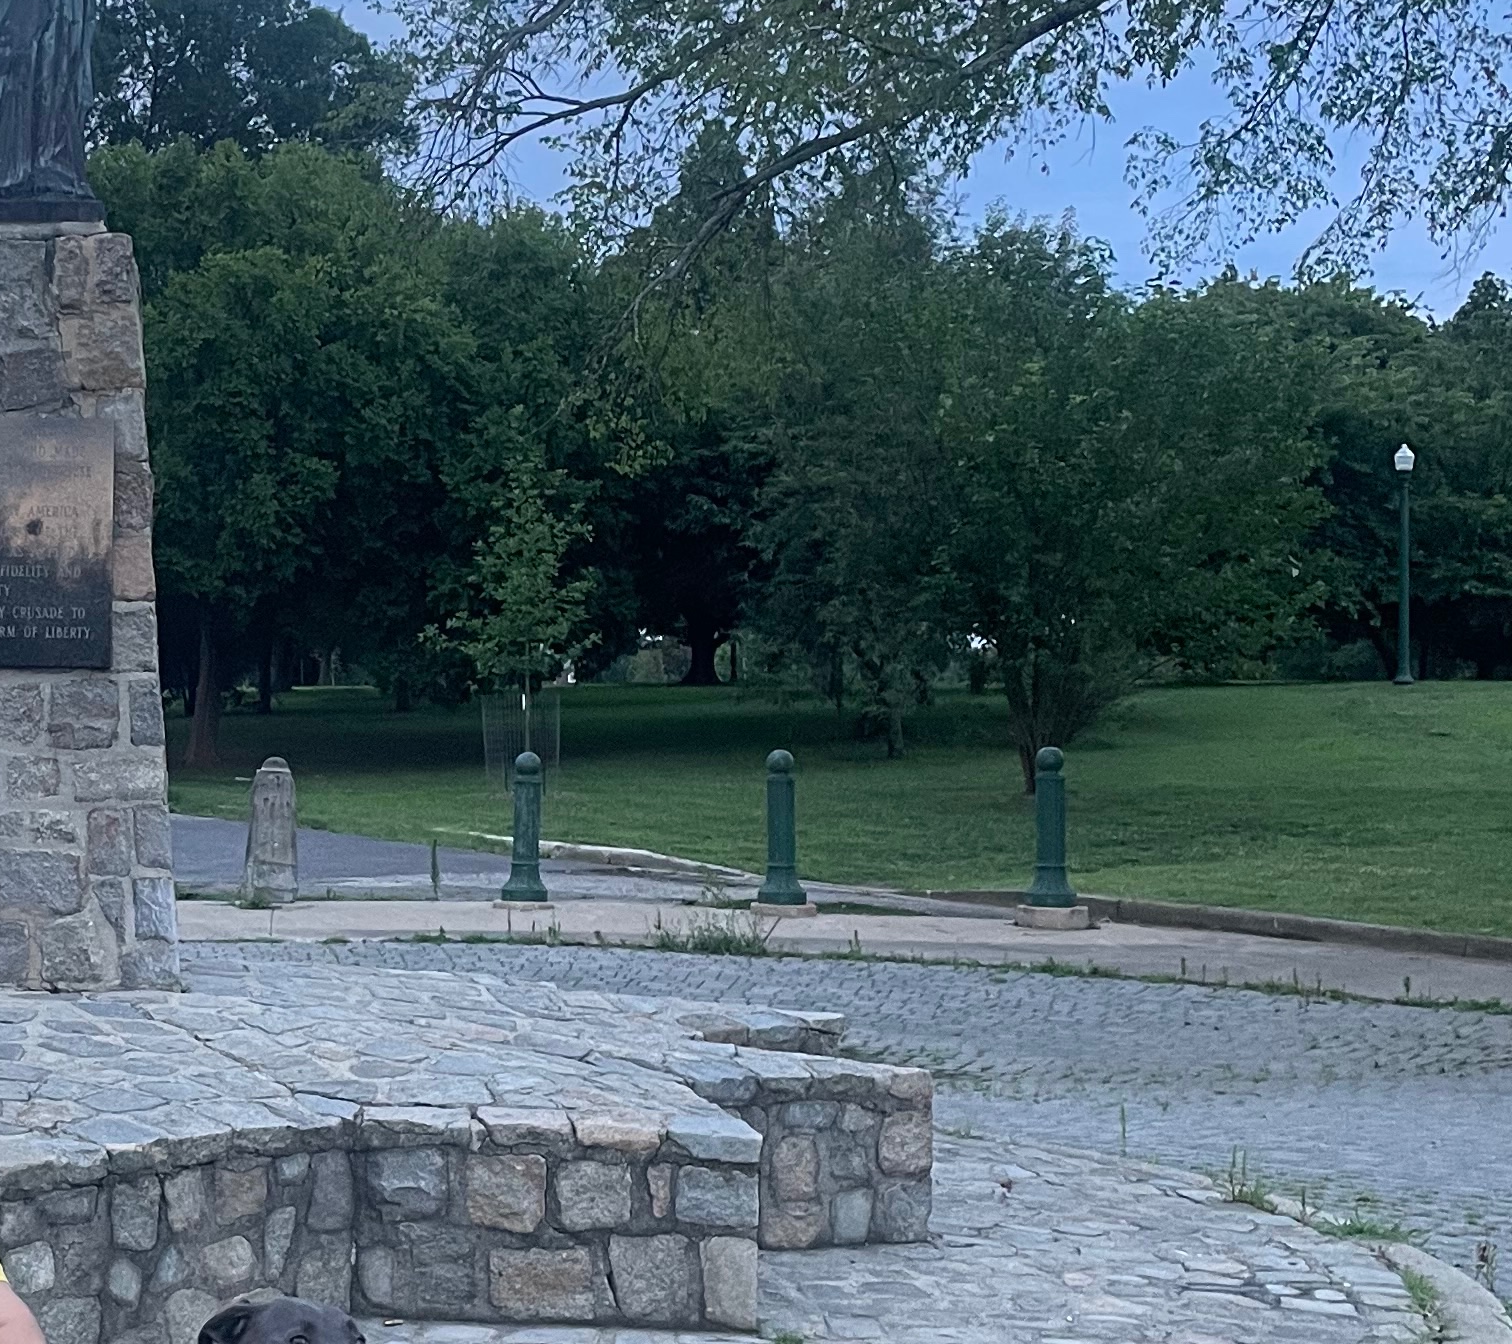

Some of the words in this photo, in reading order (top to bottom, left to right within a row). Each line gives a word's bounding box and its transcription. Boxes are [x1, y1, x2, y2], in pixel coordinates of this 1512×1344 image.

[28, 505, 79, 518] AMERICA
[0, 564, 49, 578] FIDELITY
[56, 564, 82, 578] AND
[12, 606, 64, 620] CRUSADE
[71, 606, 86, 619] TO
[23, 625, 38, 638] OF
[45, 625, 91, 639] LIBERTY
